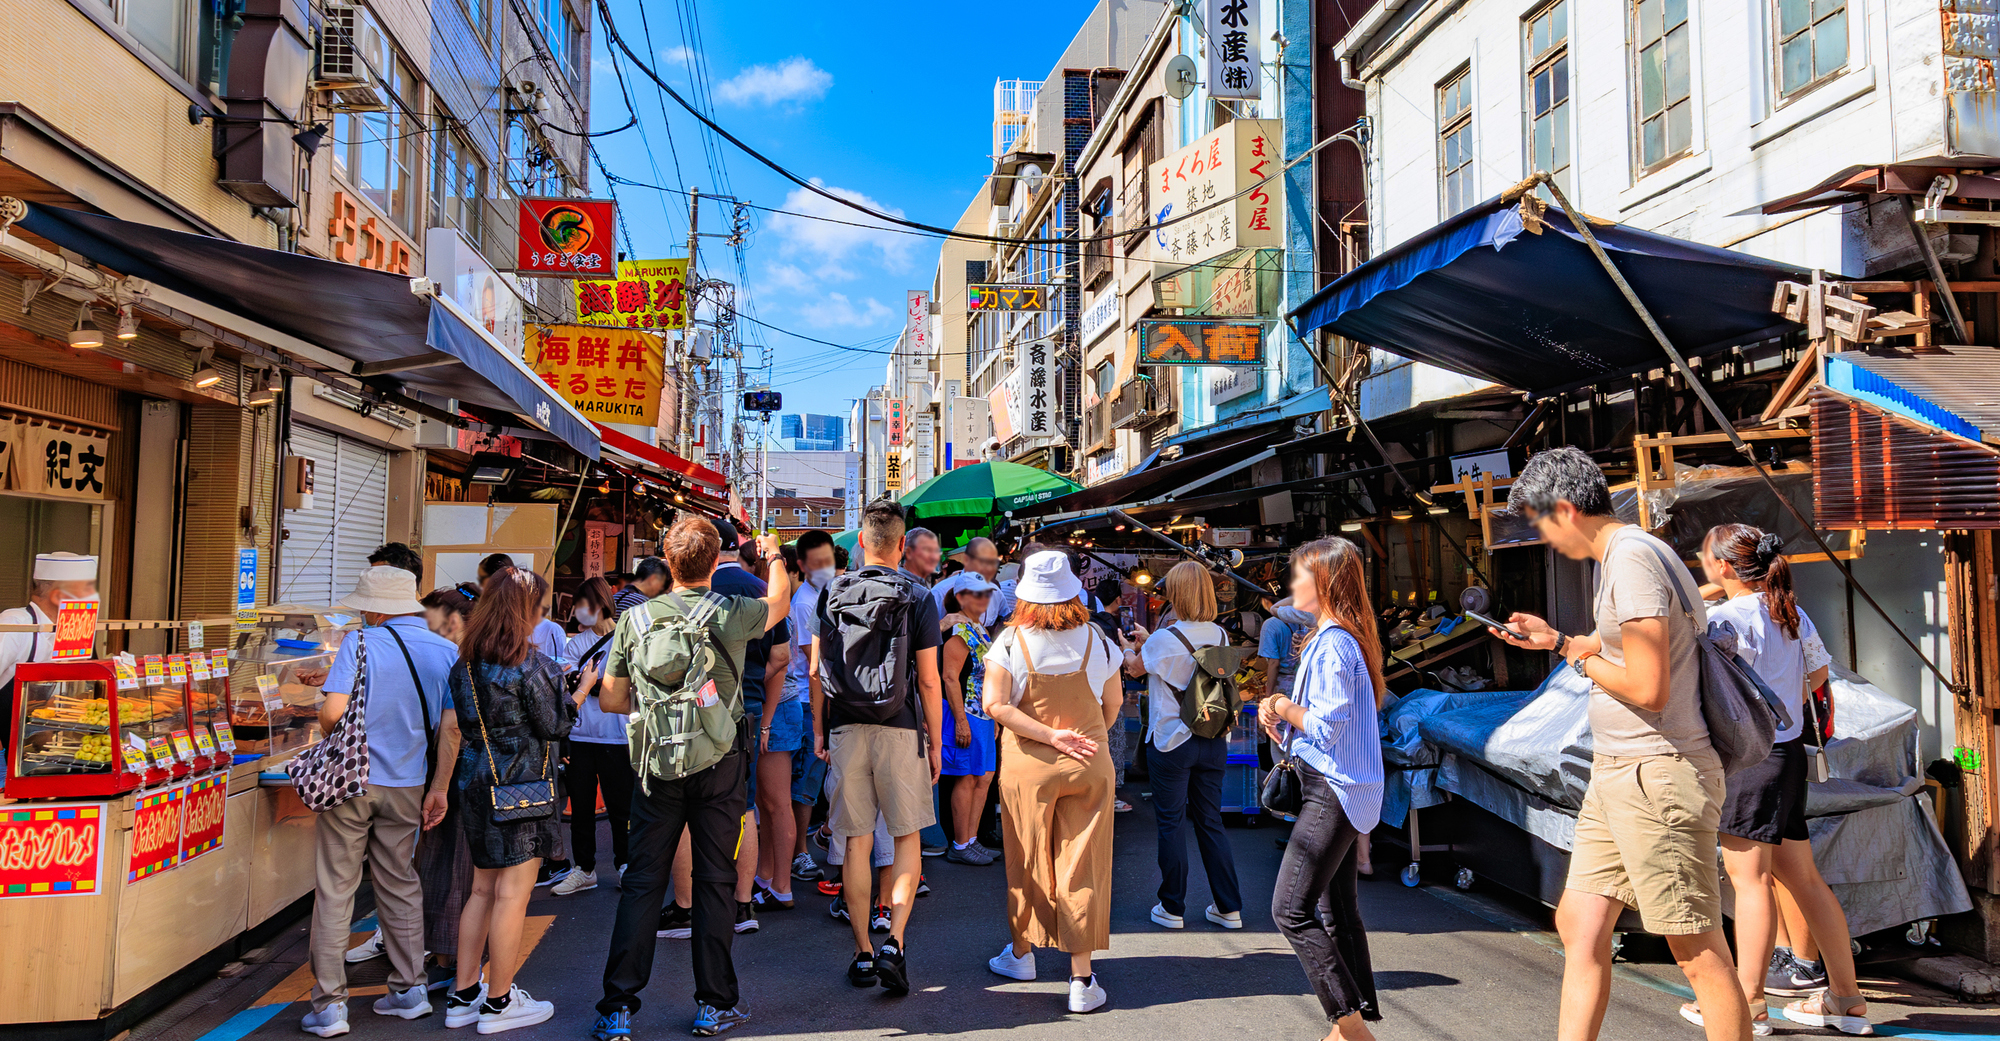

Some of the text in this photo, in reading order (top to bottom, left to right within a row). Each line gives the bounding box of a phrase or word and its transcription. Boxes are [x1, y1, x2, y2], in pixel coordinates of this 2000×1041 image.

[1162, 137, 1222, 194] まぐろ屋
[1186, 180, 1216, 213] 築地
[1247, 136, 1272, 231] まぐろ屋
[531, 252, 602, 269] うなぎ食堂
[625, 267, 680, 277] MARUKITA
[579, 278, 685, 315] 海鮮丼
[980, 287, 1041, 309] カマス
[626, 312, 683, 328] まるきた
[537, 333, 648, 372] 海鮮丼
[1148, 324, 1261, 361] 入荷
[539, 371, 646, 400] まるきた
[575, 399, 644, 417] MARUKITA
[46, 439, 105, 494] 紀文
[887, 455, 900, 479] 茶
[0, 821, 96, 870] たかグルメ
